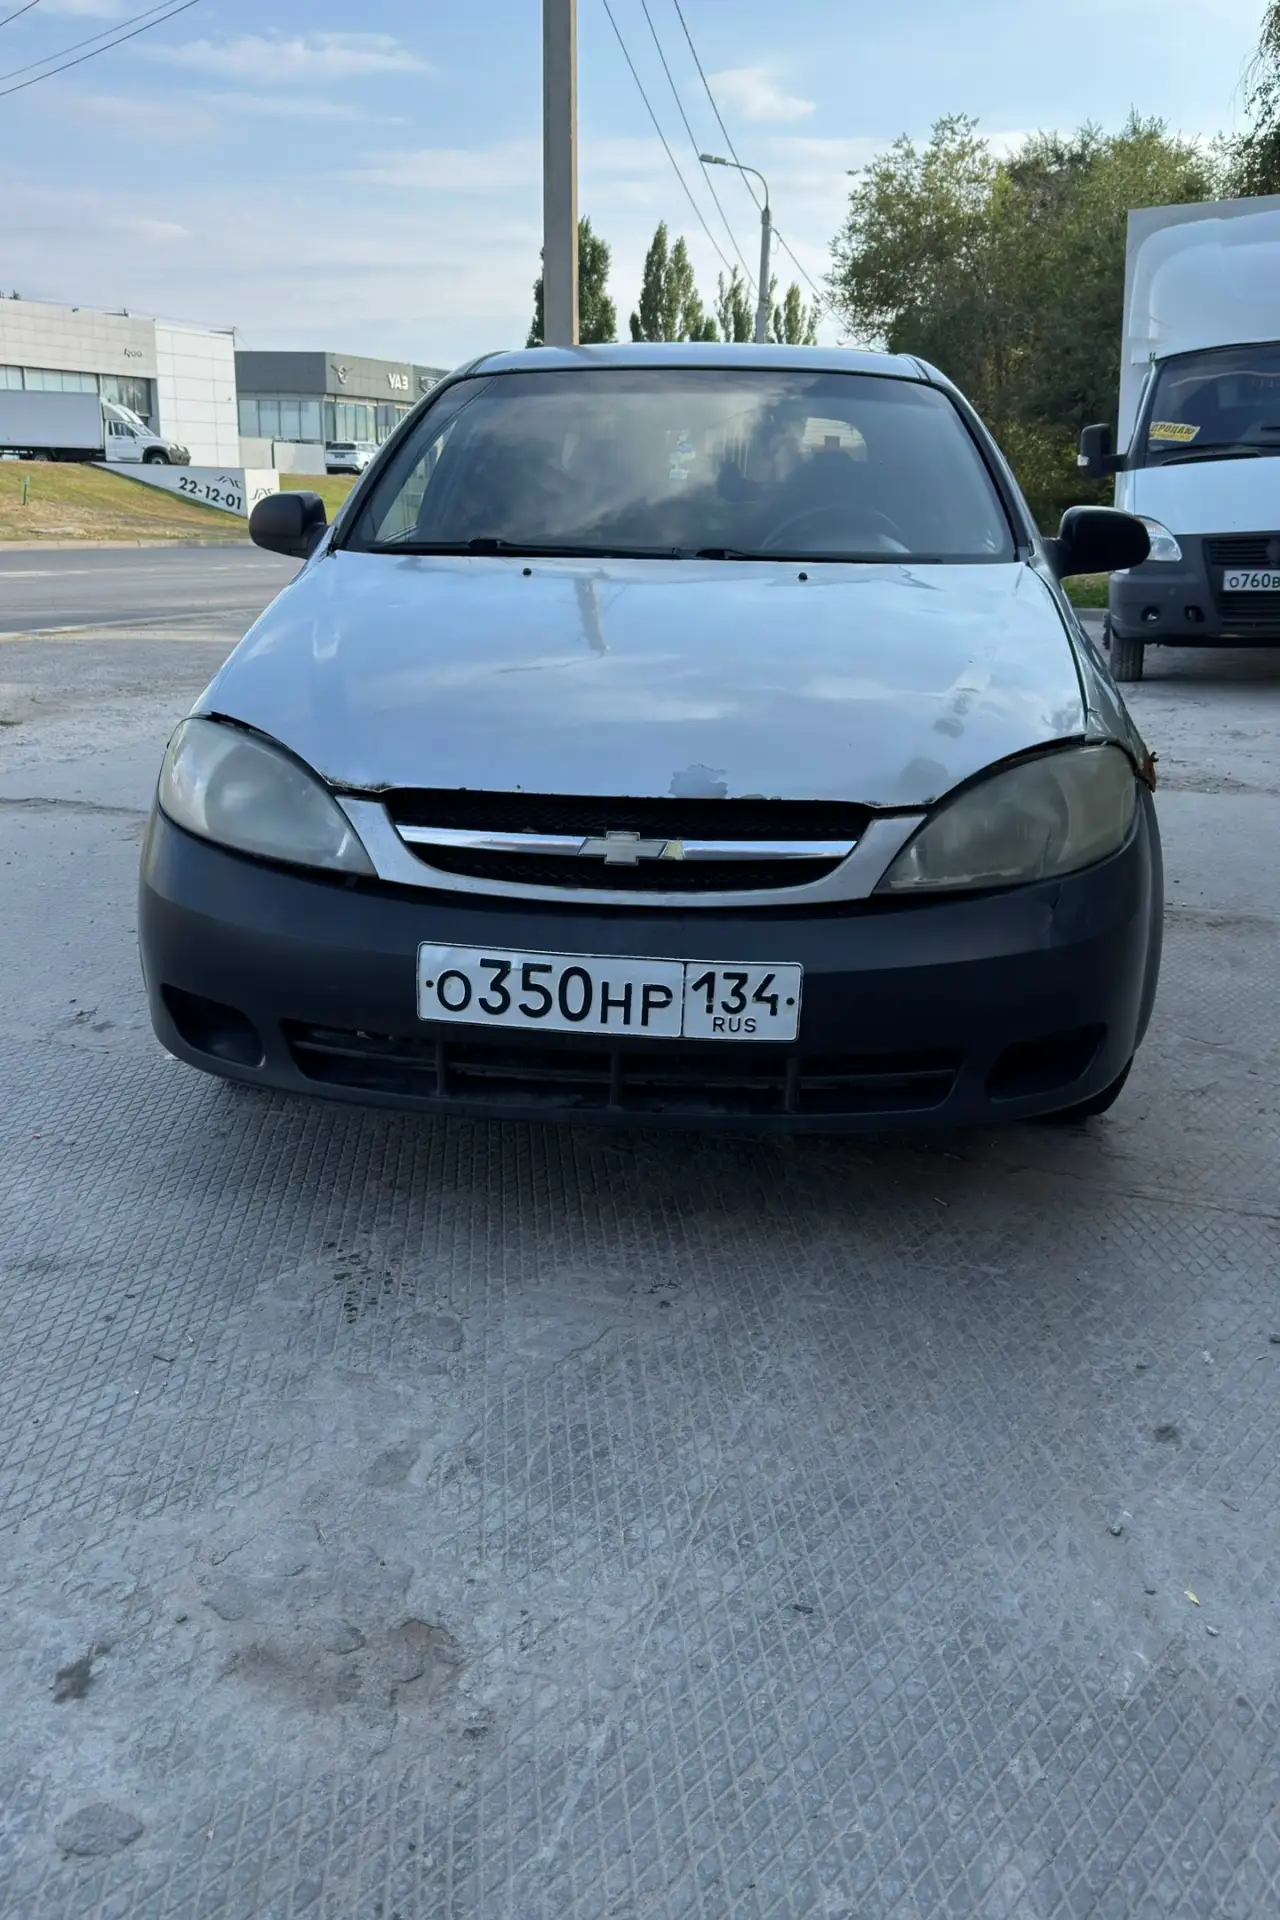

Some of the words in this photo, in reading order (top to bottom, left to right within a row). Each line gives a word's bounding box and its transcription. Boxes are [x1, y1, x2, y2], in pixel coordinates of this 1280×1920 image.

[387, 372, 409, 390] УАЗ
[179, 476, 242, 510] 22-12-01
[691, 970, 779, 1017] 134
[712, 1016, 757, 1033] RUS
